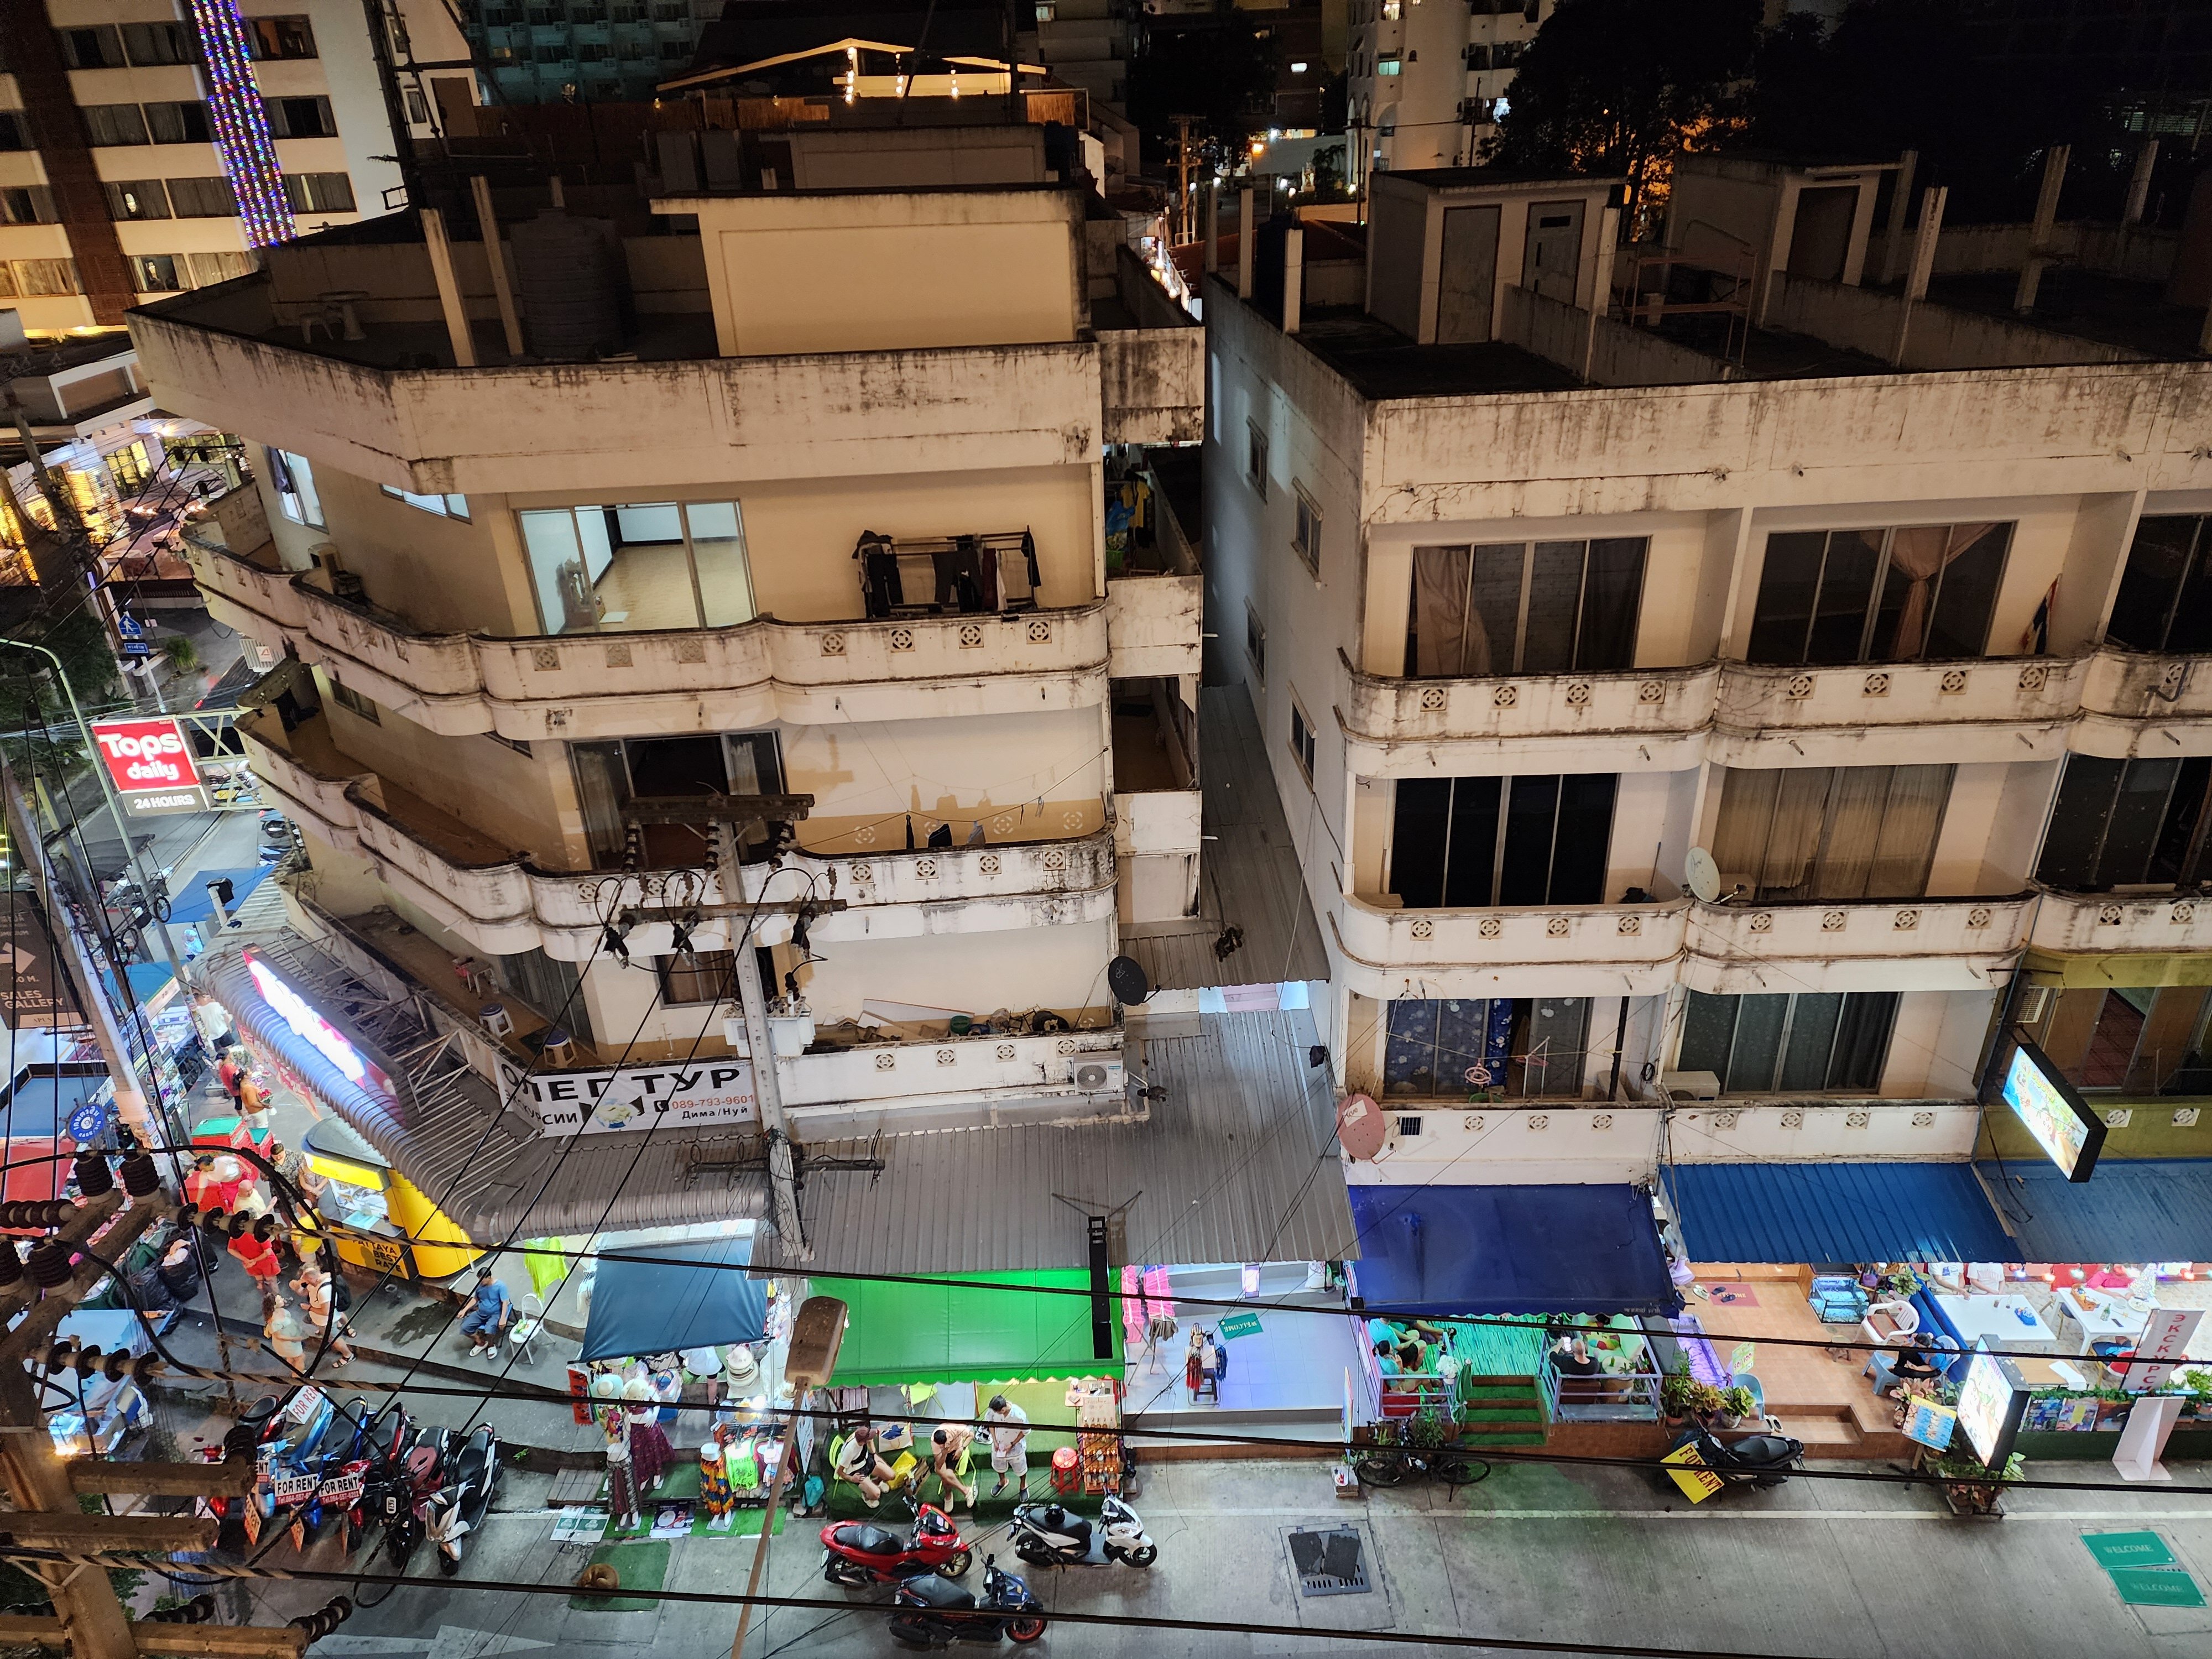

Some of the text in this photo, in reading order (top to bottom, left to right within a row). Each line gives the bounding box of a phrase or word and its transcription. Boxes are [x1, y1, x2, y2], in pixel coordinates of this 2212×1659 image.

[98, 733, 183, 761] Tops
[127, 760, 180, 780] daily
[134, 794, 196, 810] 24 HOURS
[630, 1068, 740, 1094] ТУР
[672, 1094, 754, 1110] 089-793-9601
[373, 1250, 398, 1262] BEST
[1223, 1321, 1258, 1333] WELCOME
[291, 1385, 320, 1420] FOR REN
[277, 1478, 294, 1495] FOR
[296, 1475, 317, 1491] RENT
[320, 1475, 358, 1495] FOR RENT
[2103, 1544, 2154, 1554] WELCOME
[2130, 1582, 2184, 1593] WELCOME
